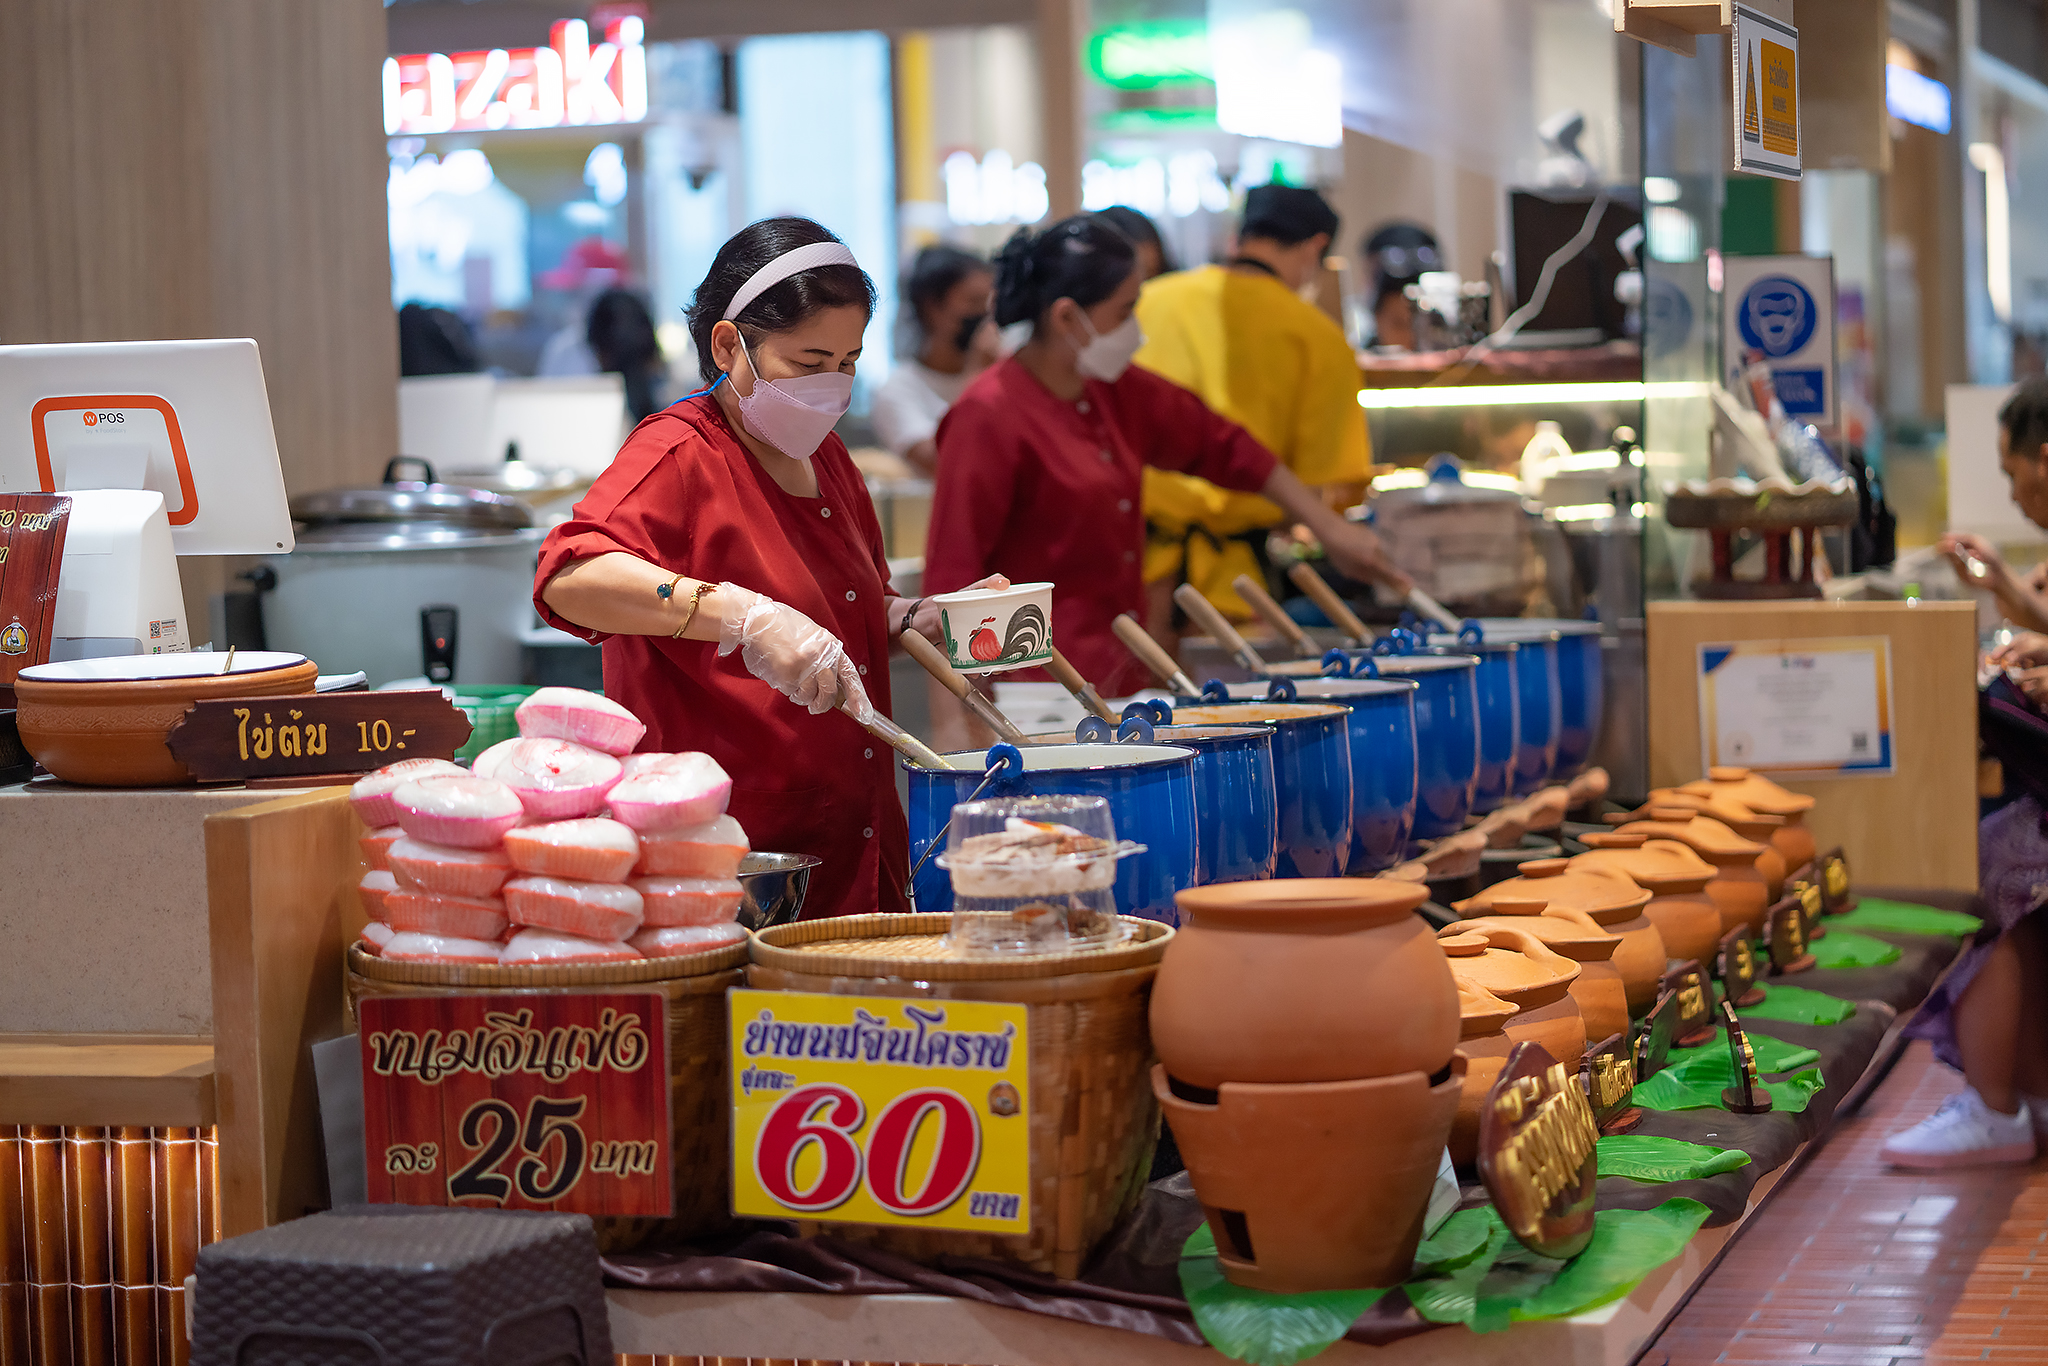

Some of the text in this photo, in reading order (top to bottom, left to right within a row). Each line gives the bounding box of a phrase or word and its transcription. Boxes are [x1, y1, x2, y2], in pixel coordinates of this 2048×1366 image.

[98, 412, 125, 424] POS
[20, 513, 51, 531] บาท
[234, 708, 416, 761] ไข่ต้ม 10.-
[743, 1006, 1017, 1069] ยำขนมจีนโคราช
[386, 1095, 658, 1205] ละ 25 บาท
[754, 1082, 1021, 1220] 60 บาท
